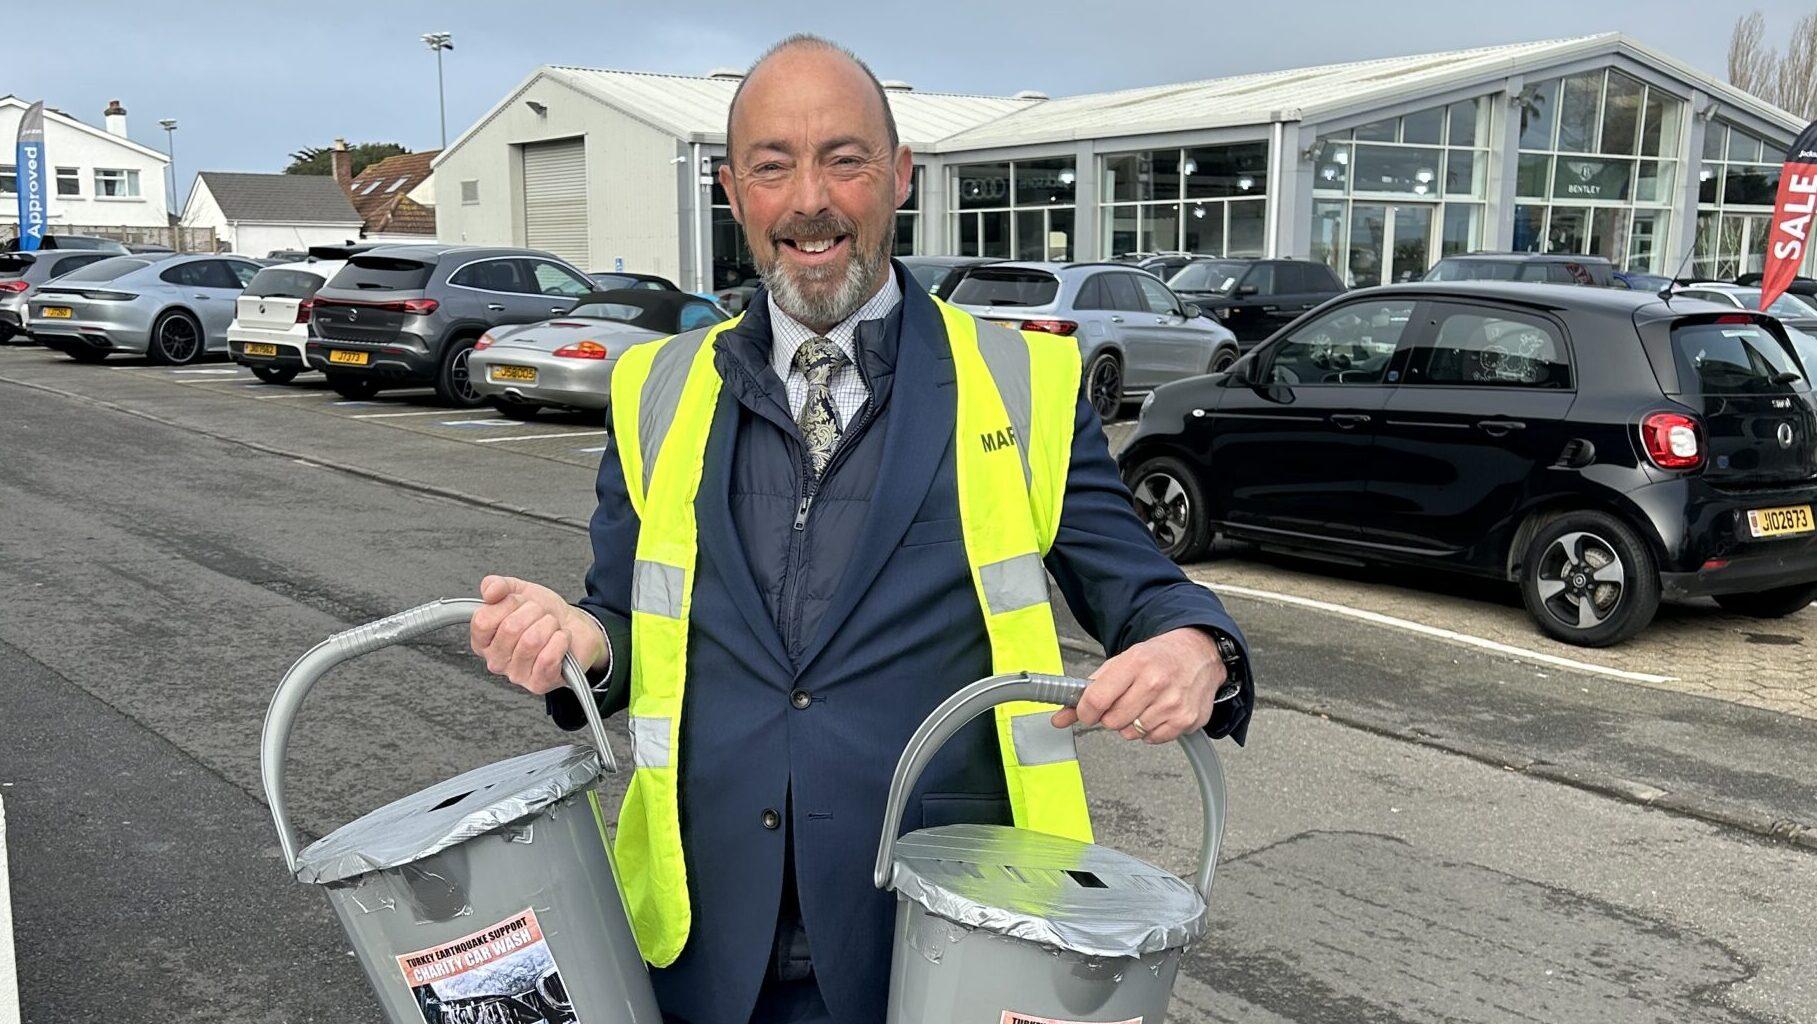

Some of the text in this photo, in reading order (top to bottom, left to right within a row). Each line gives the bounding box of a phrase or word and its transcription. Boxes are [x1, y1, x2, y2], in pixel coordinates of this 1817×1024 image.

[24, 146, 42, 238] Approved
[1568, 184, 1600, 194] BENTLEY
[1774, 174, 1817, 260] SALE
[1762, 509, 1808, 532] J102873
[406, 916, 528, 969] TURKEY EARTHQUAKE SUPPORT
[413, 928, 532, 982] CHARITY CAR WASH
